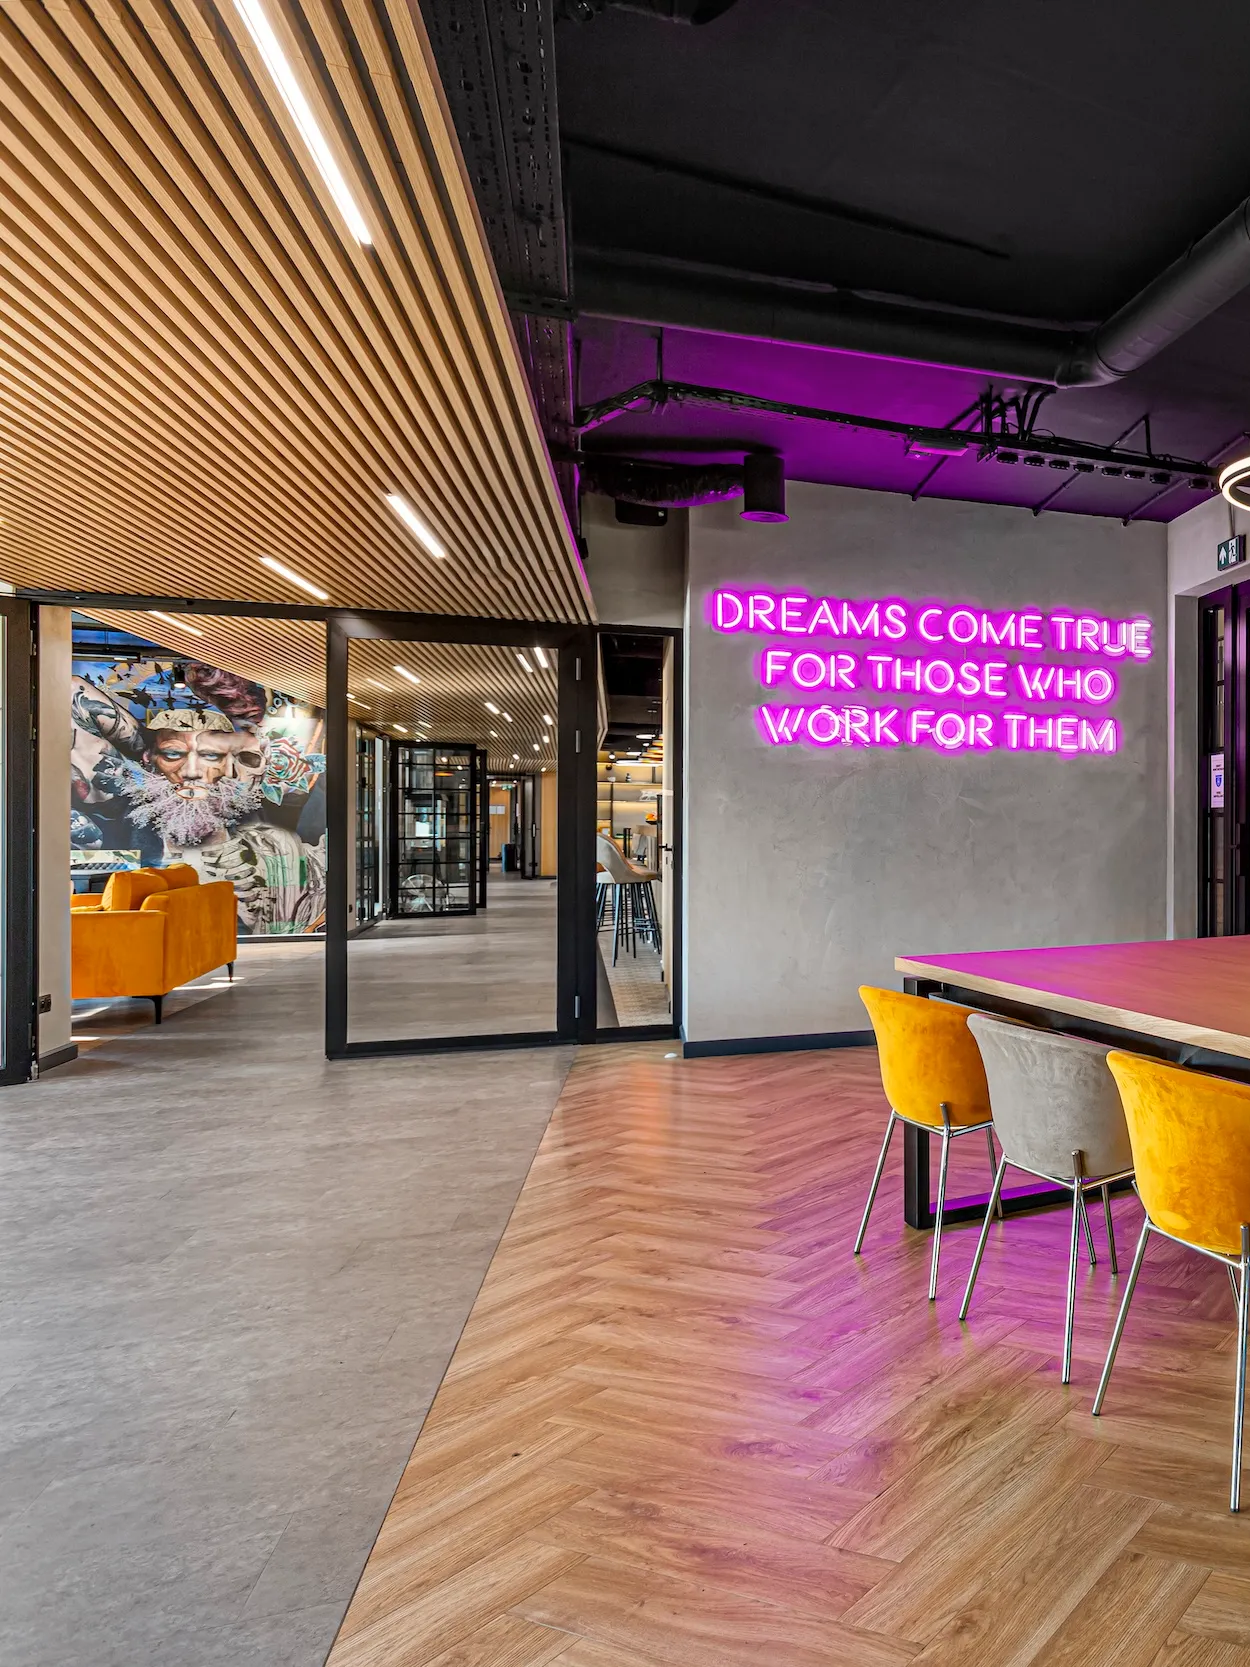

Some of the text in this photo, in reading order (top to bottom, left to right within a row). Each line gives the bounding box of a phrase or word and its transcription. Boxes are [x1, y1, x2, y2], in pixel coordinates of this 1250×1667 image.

[715, 592, 1152, 655] DREAMS COME TRUE
[766, 651, 1113, 701] FOR THOSE WHO
[761, 705, 1115, 753] WORK FOR THEM
